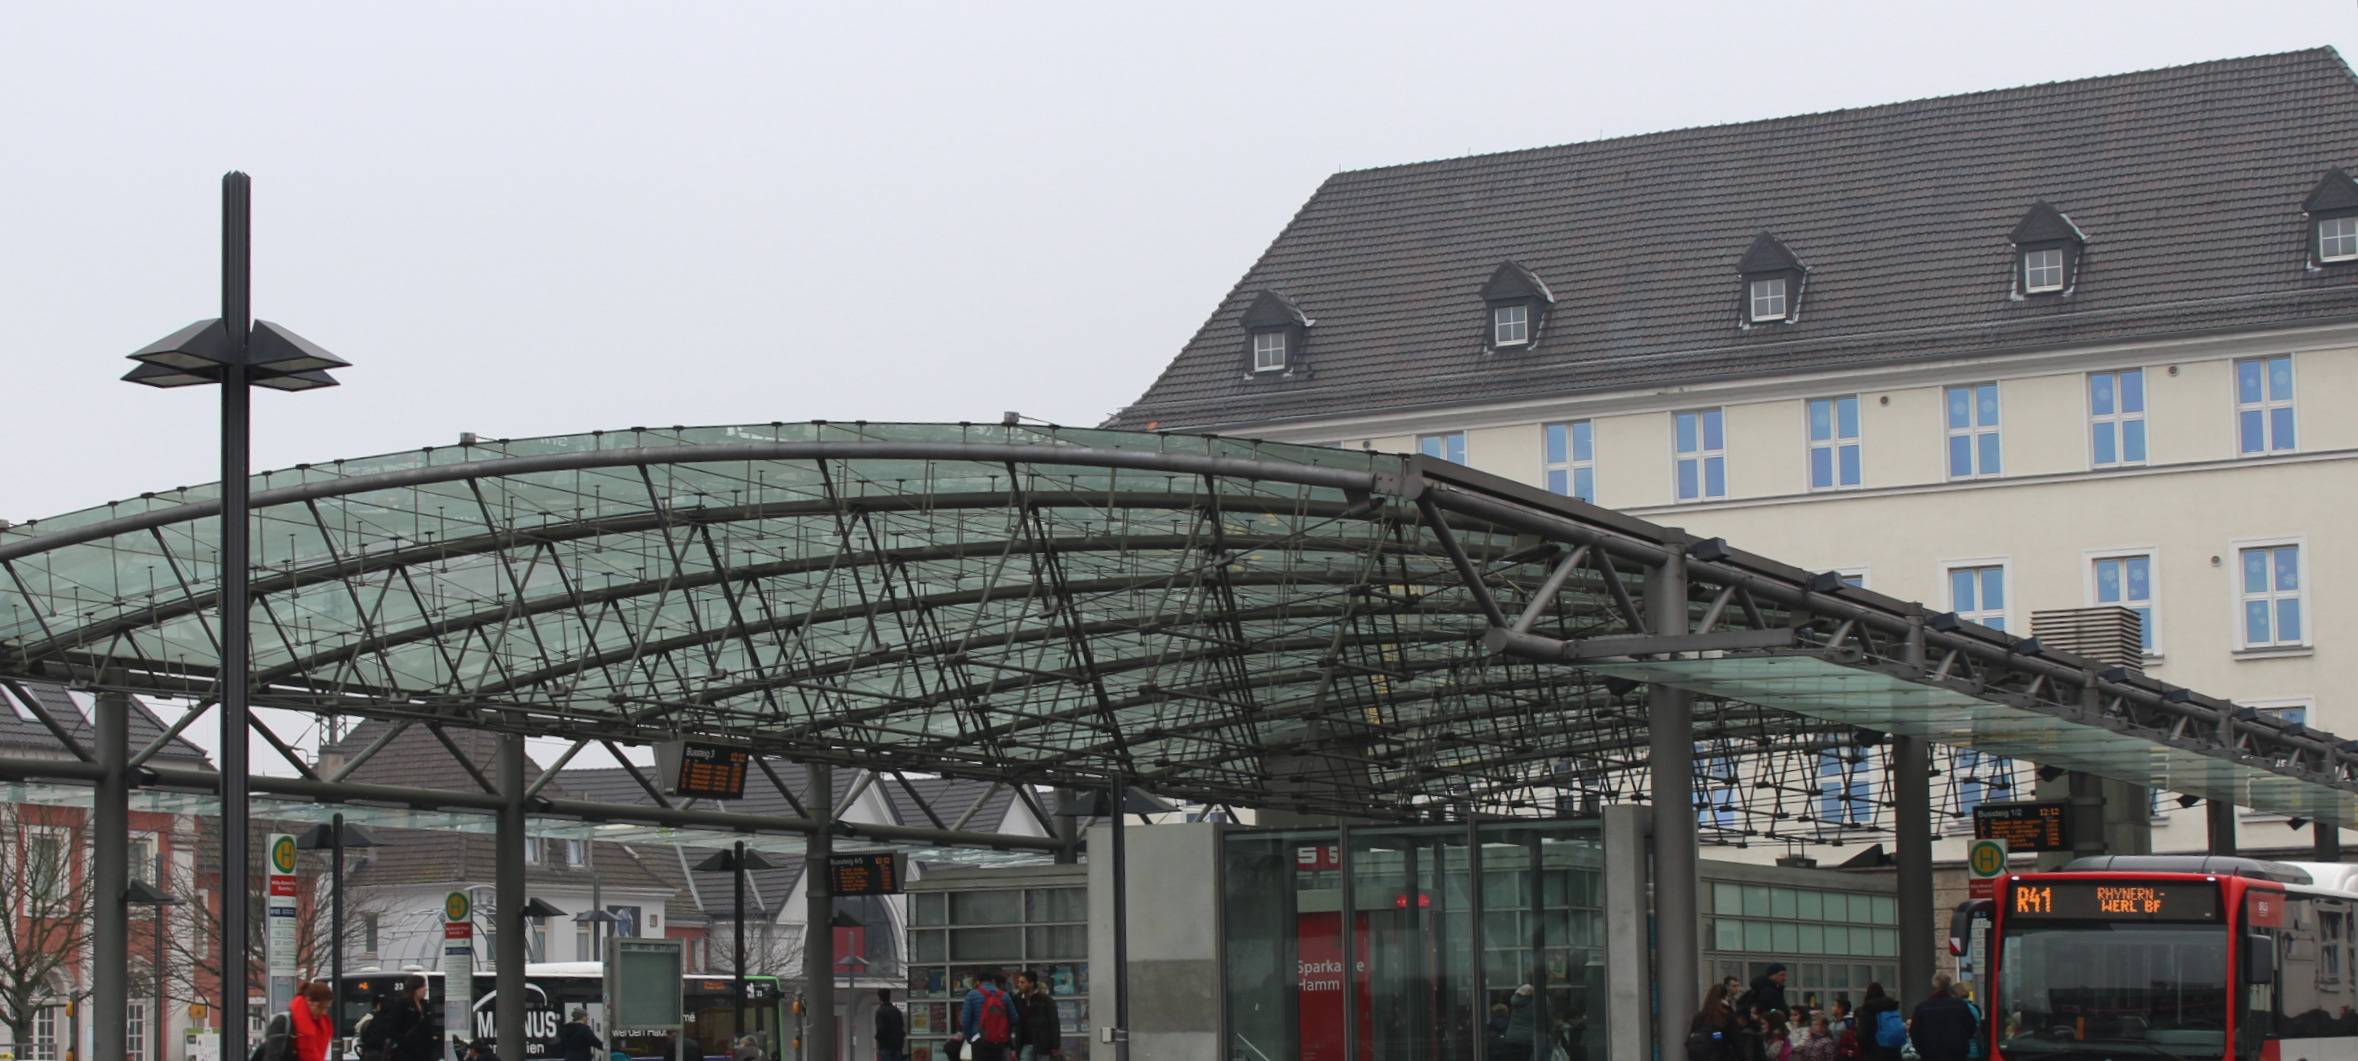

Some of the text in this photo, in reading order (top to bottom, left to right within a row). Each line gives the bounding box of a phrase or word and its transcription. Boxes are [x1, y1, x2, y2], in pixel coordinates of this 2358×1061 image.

[2016, 886, 2052, 913] R41
[2096, 887, 2154, 901] RHYNERN
[2101, 900, 2162, 913] WERL BF
[1298, 959, 1365, 976] Sparkae
[394, 982, 404, 991] 23
[477, 1011, 557, 1038] MNUS
